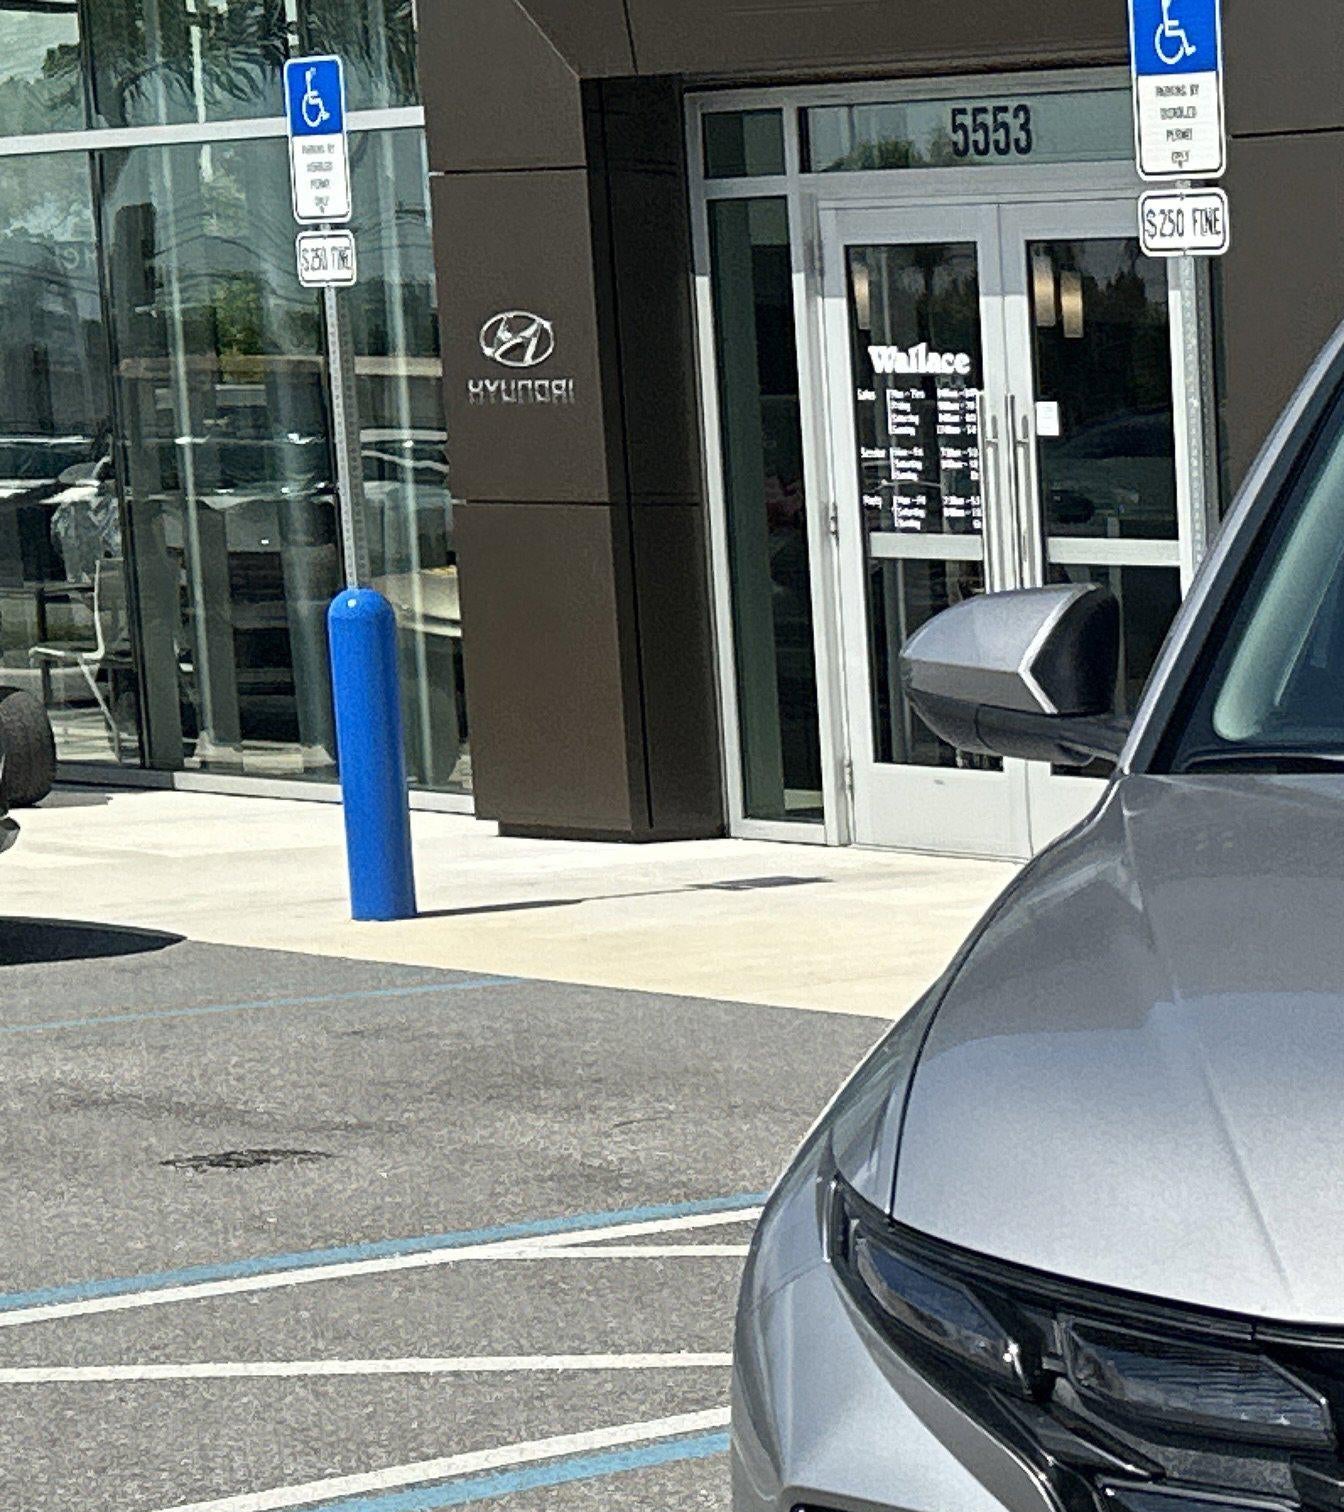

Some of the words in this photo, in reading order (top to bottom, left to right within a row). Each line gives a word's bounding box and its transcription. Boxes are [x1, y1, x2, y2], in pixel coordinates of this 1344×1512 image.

[951, 104, 1033, 158] 5553
[1144, 208, 1185, 240] $250
[1191, 207, 1221, 237] FINE
[867, 342, 971, 375] Wallace
[467, 379, 575, 404] HYUNDAI
